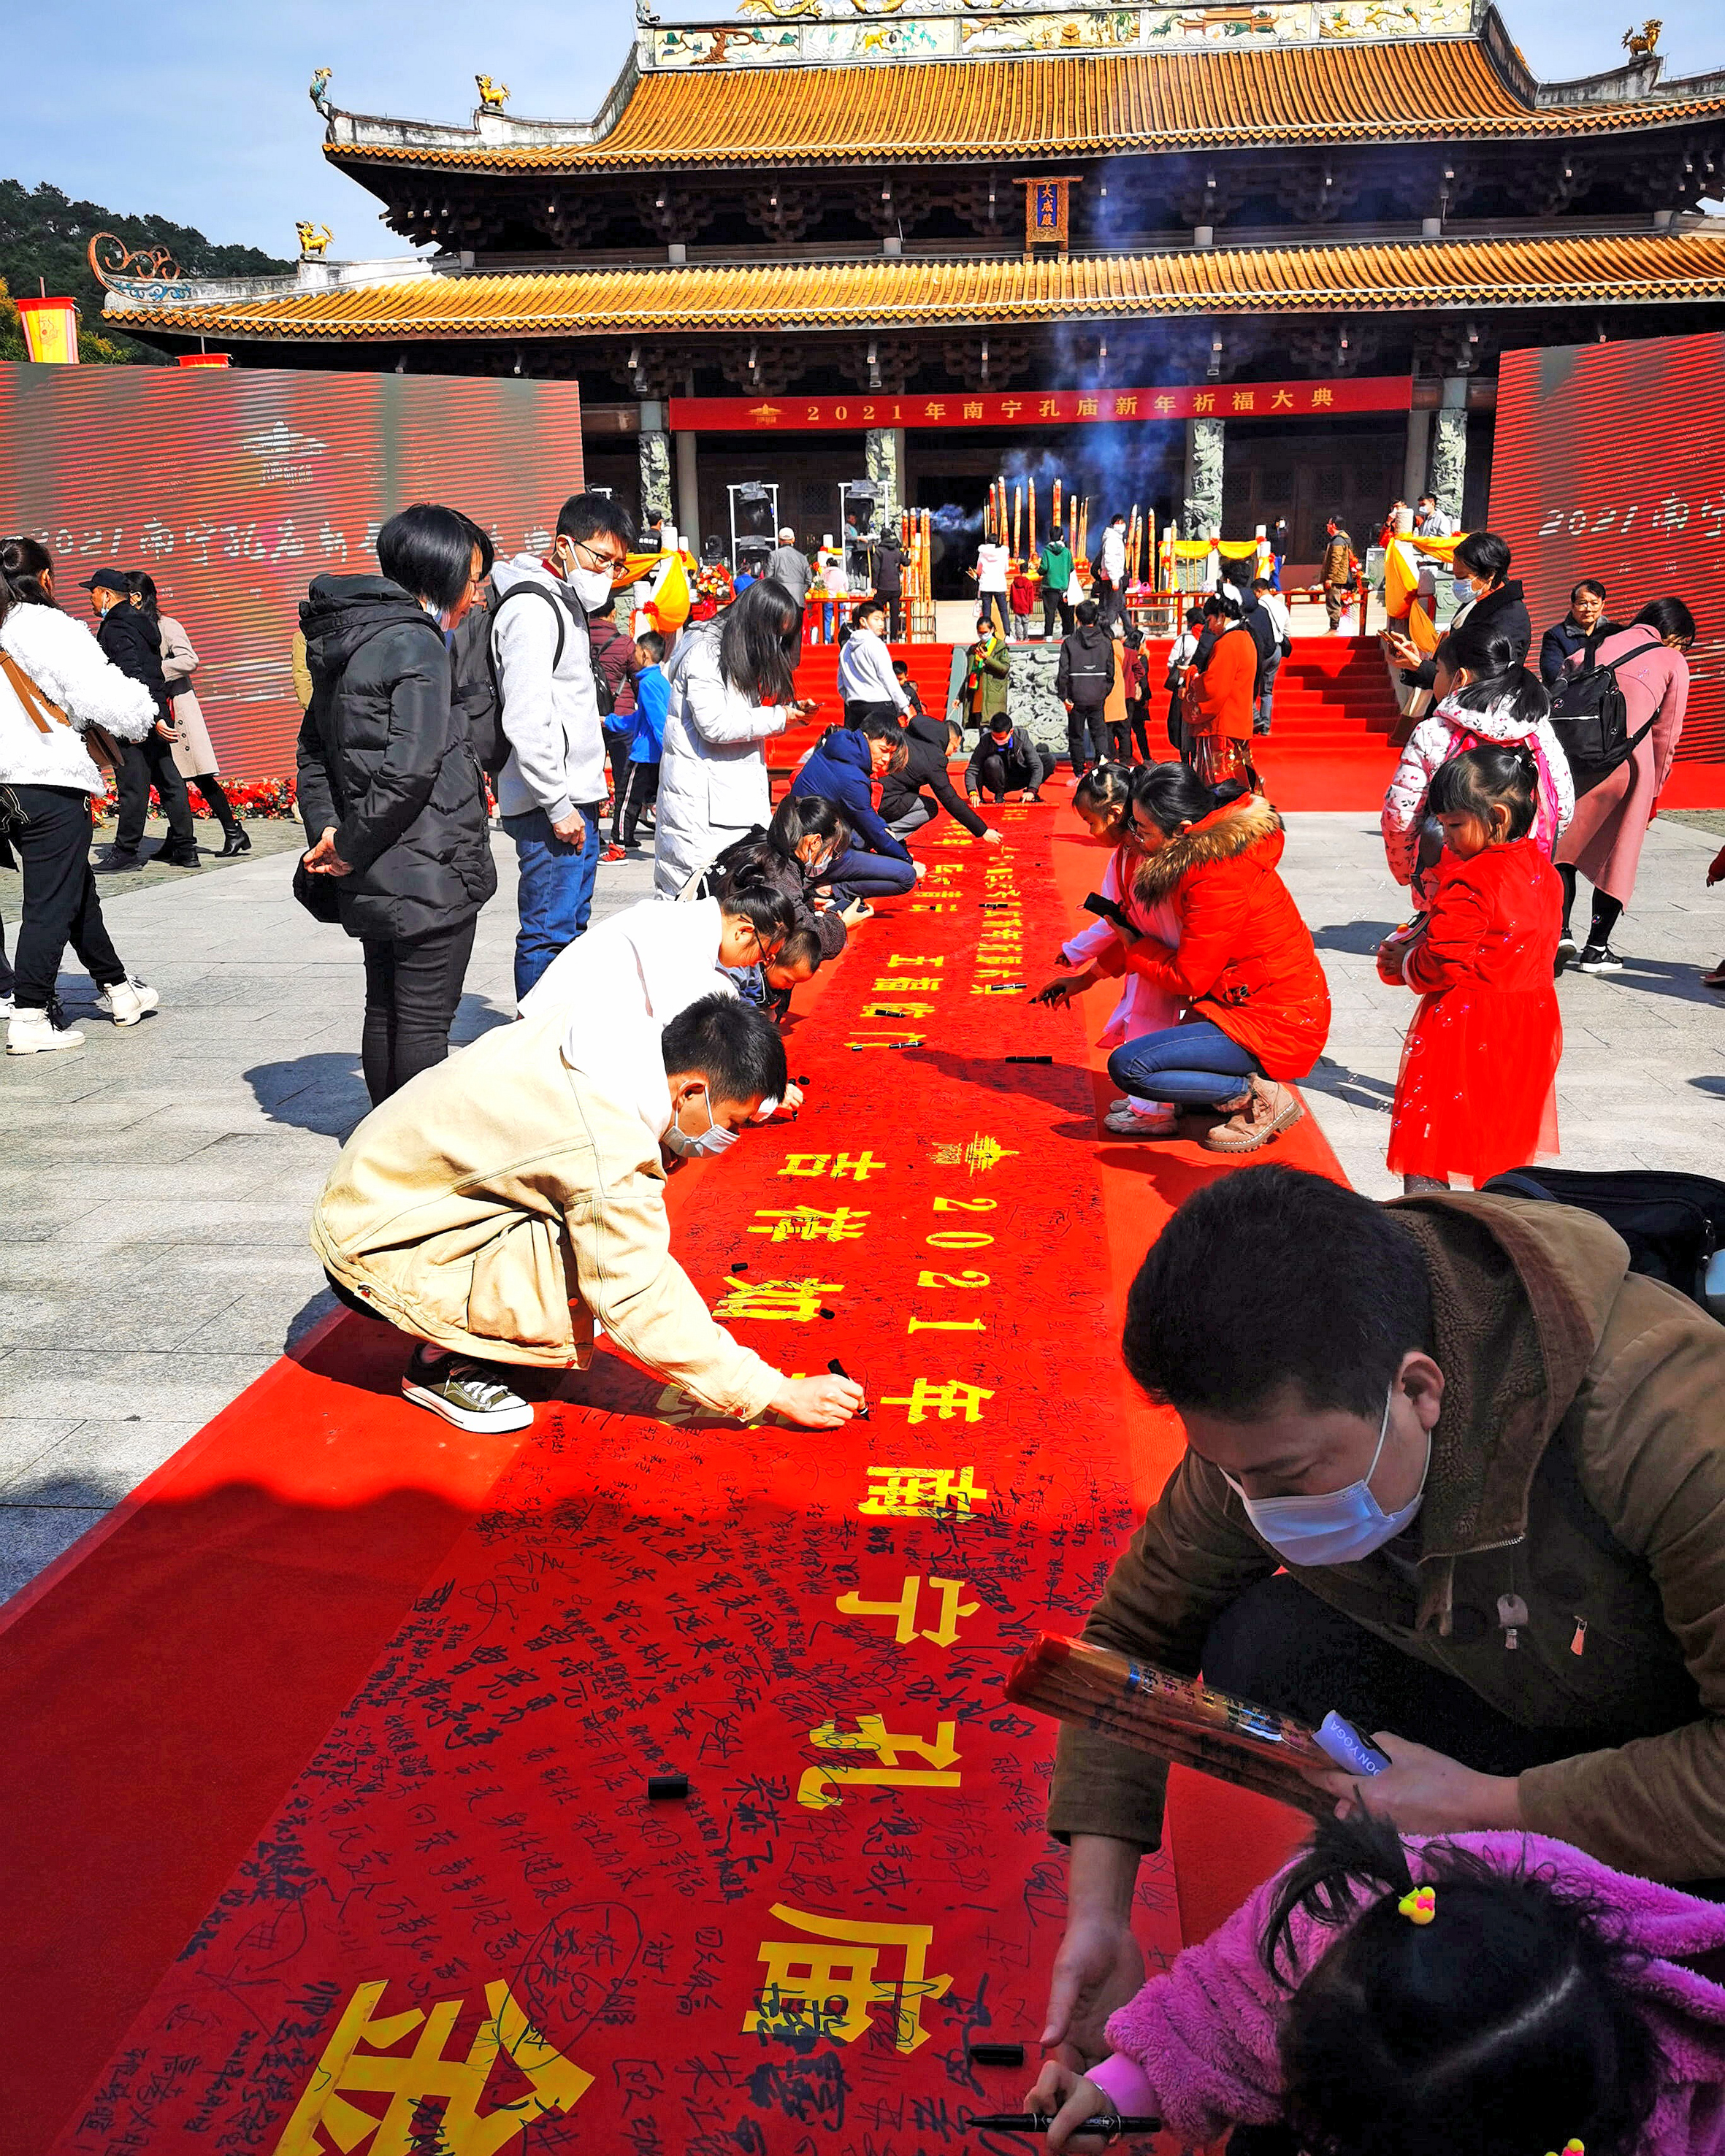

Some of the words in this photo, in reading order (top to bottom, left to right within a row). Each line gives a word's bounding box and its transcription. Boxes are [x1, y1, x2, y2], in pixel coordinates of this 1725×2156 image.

[1041, 184, 1055, 226] 大成殿
[808, 388, 1334, 421] 2021年南宁孔庙新年祈福大典
[743, 1196, 998, 2053] 2021年南宁孔庙
[1330, 1720, 1359, 1757] YOGA
